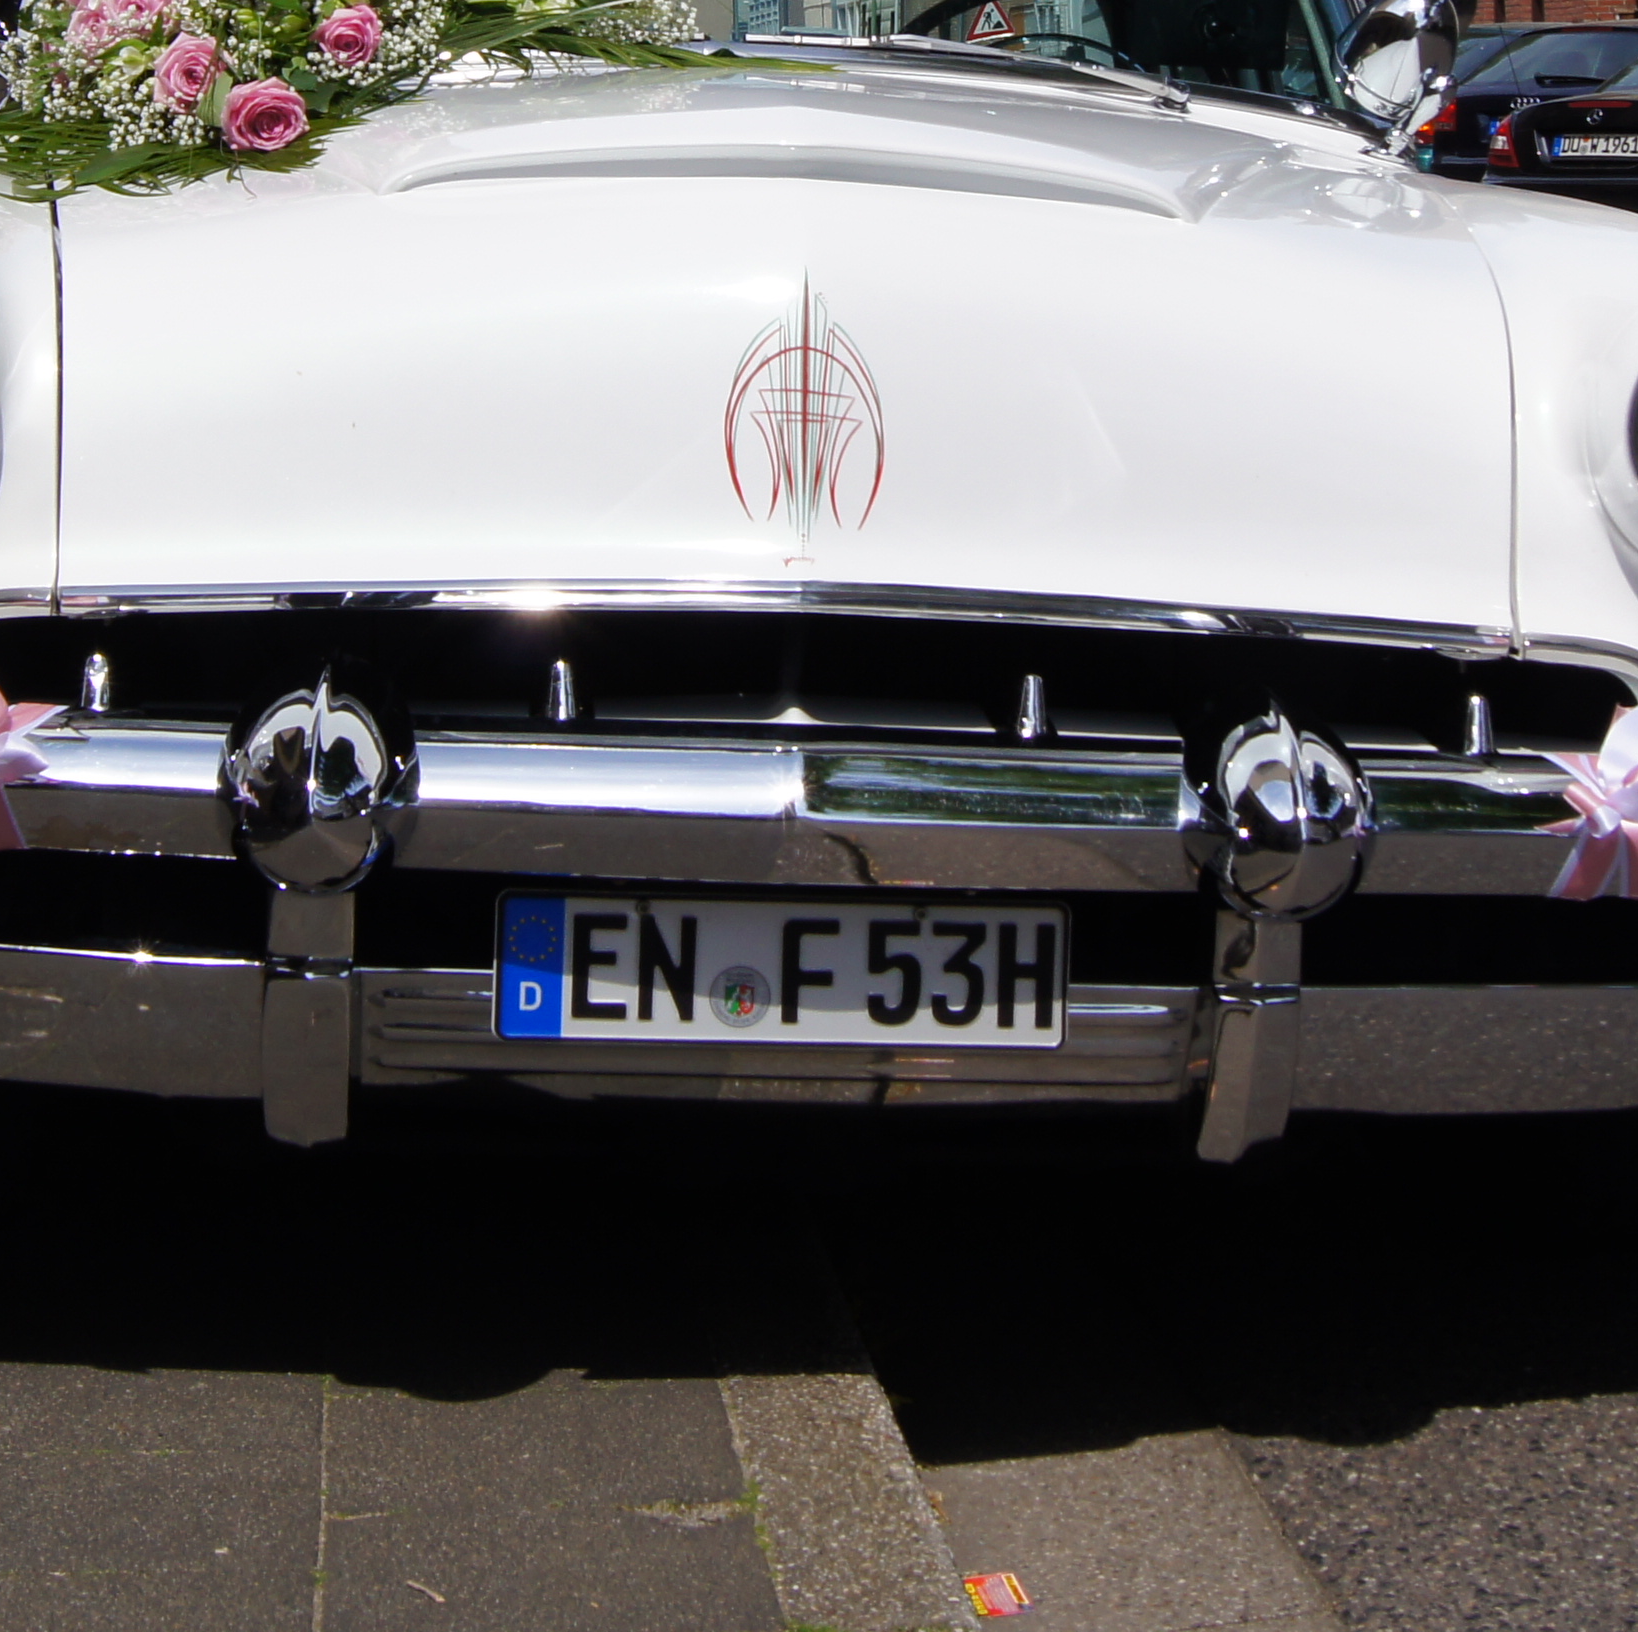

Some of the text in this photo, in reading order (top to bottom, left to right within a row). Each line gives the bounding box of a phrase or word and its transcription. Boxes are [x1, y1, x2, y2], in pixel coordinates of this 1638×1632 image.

[1561, 135, 1581, 154] DU
[570, 913, 1057, 1030] EN F 53H
[519, 980, 543, 1012] D
